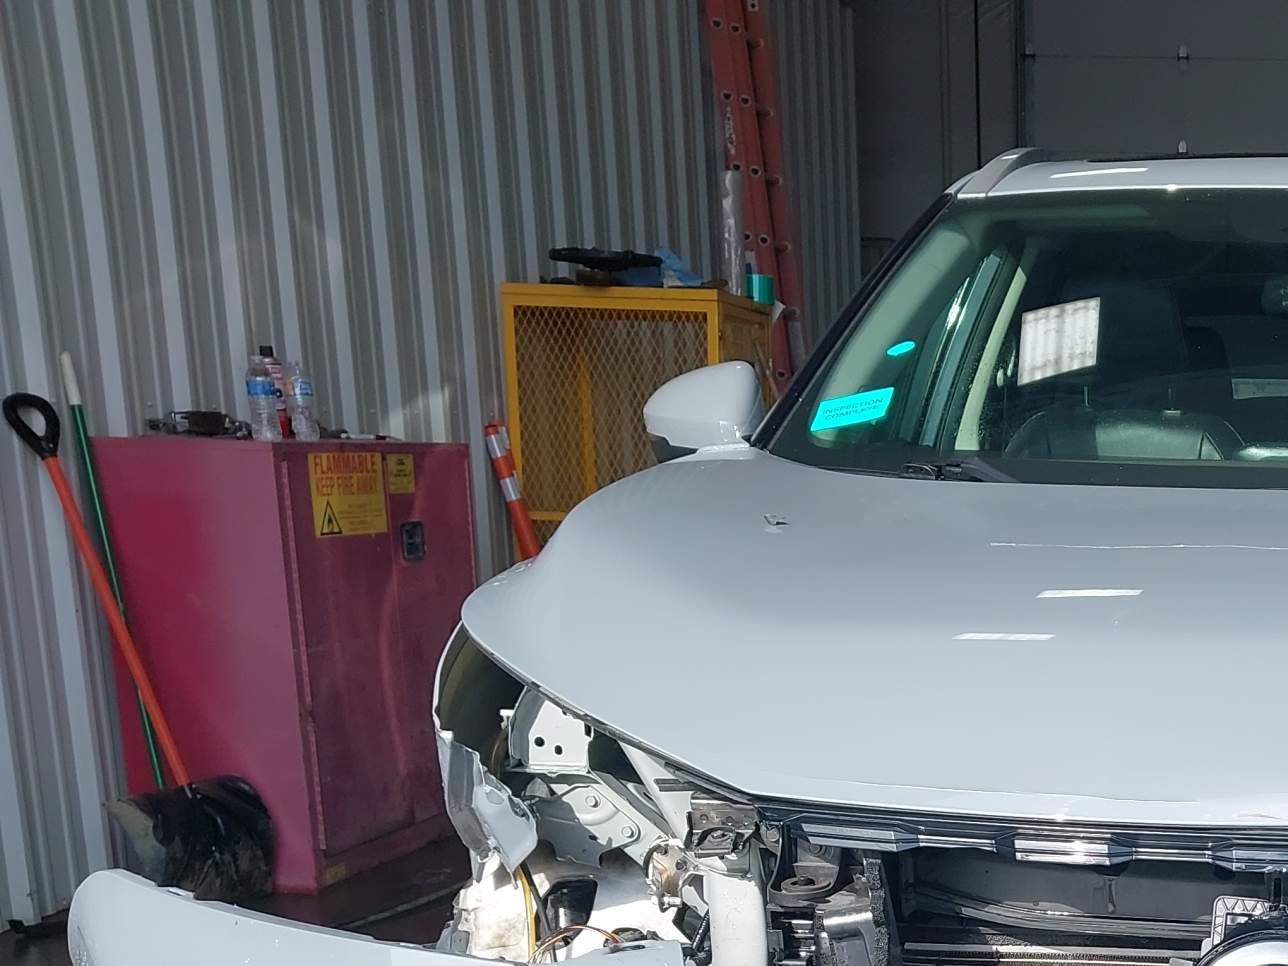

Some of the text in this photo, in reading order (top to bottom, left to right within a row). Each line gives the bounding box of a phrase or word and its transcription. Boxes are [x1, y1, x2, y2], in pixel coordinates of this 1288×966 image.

[822, 398, 884, 415] INSPECTION
[313, 454, 377, 475] FLAMMABLE
[315, 474, 379, 496] KEEP FIRE AWAY
